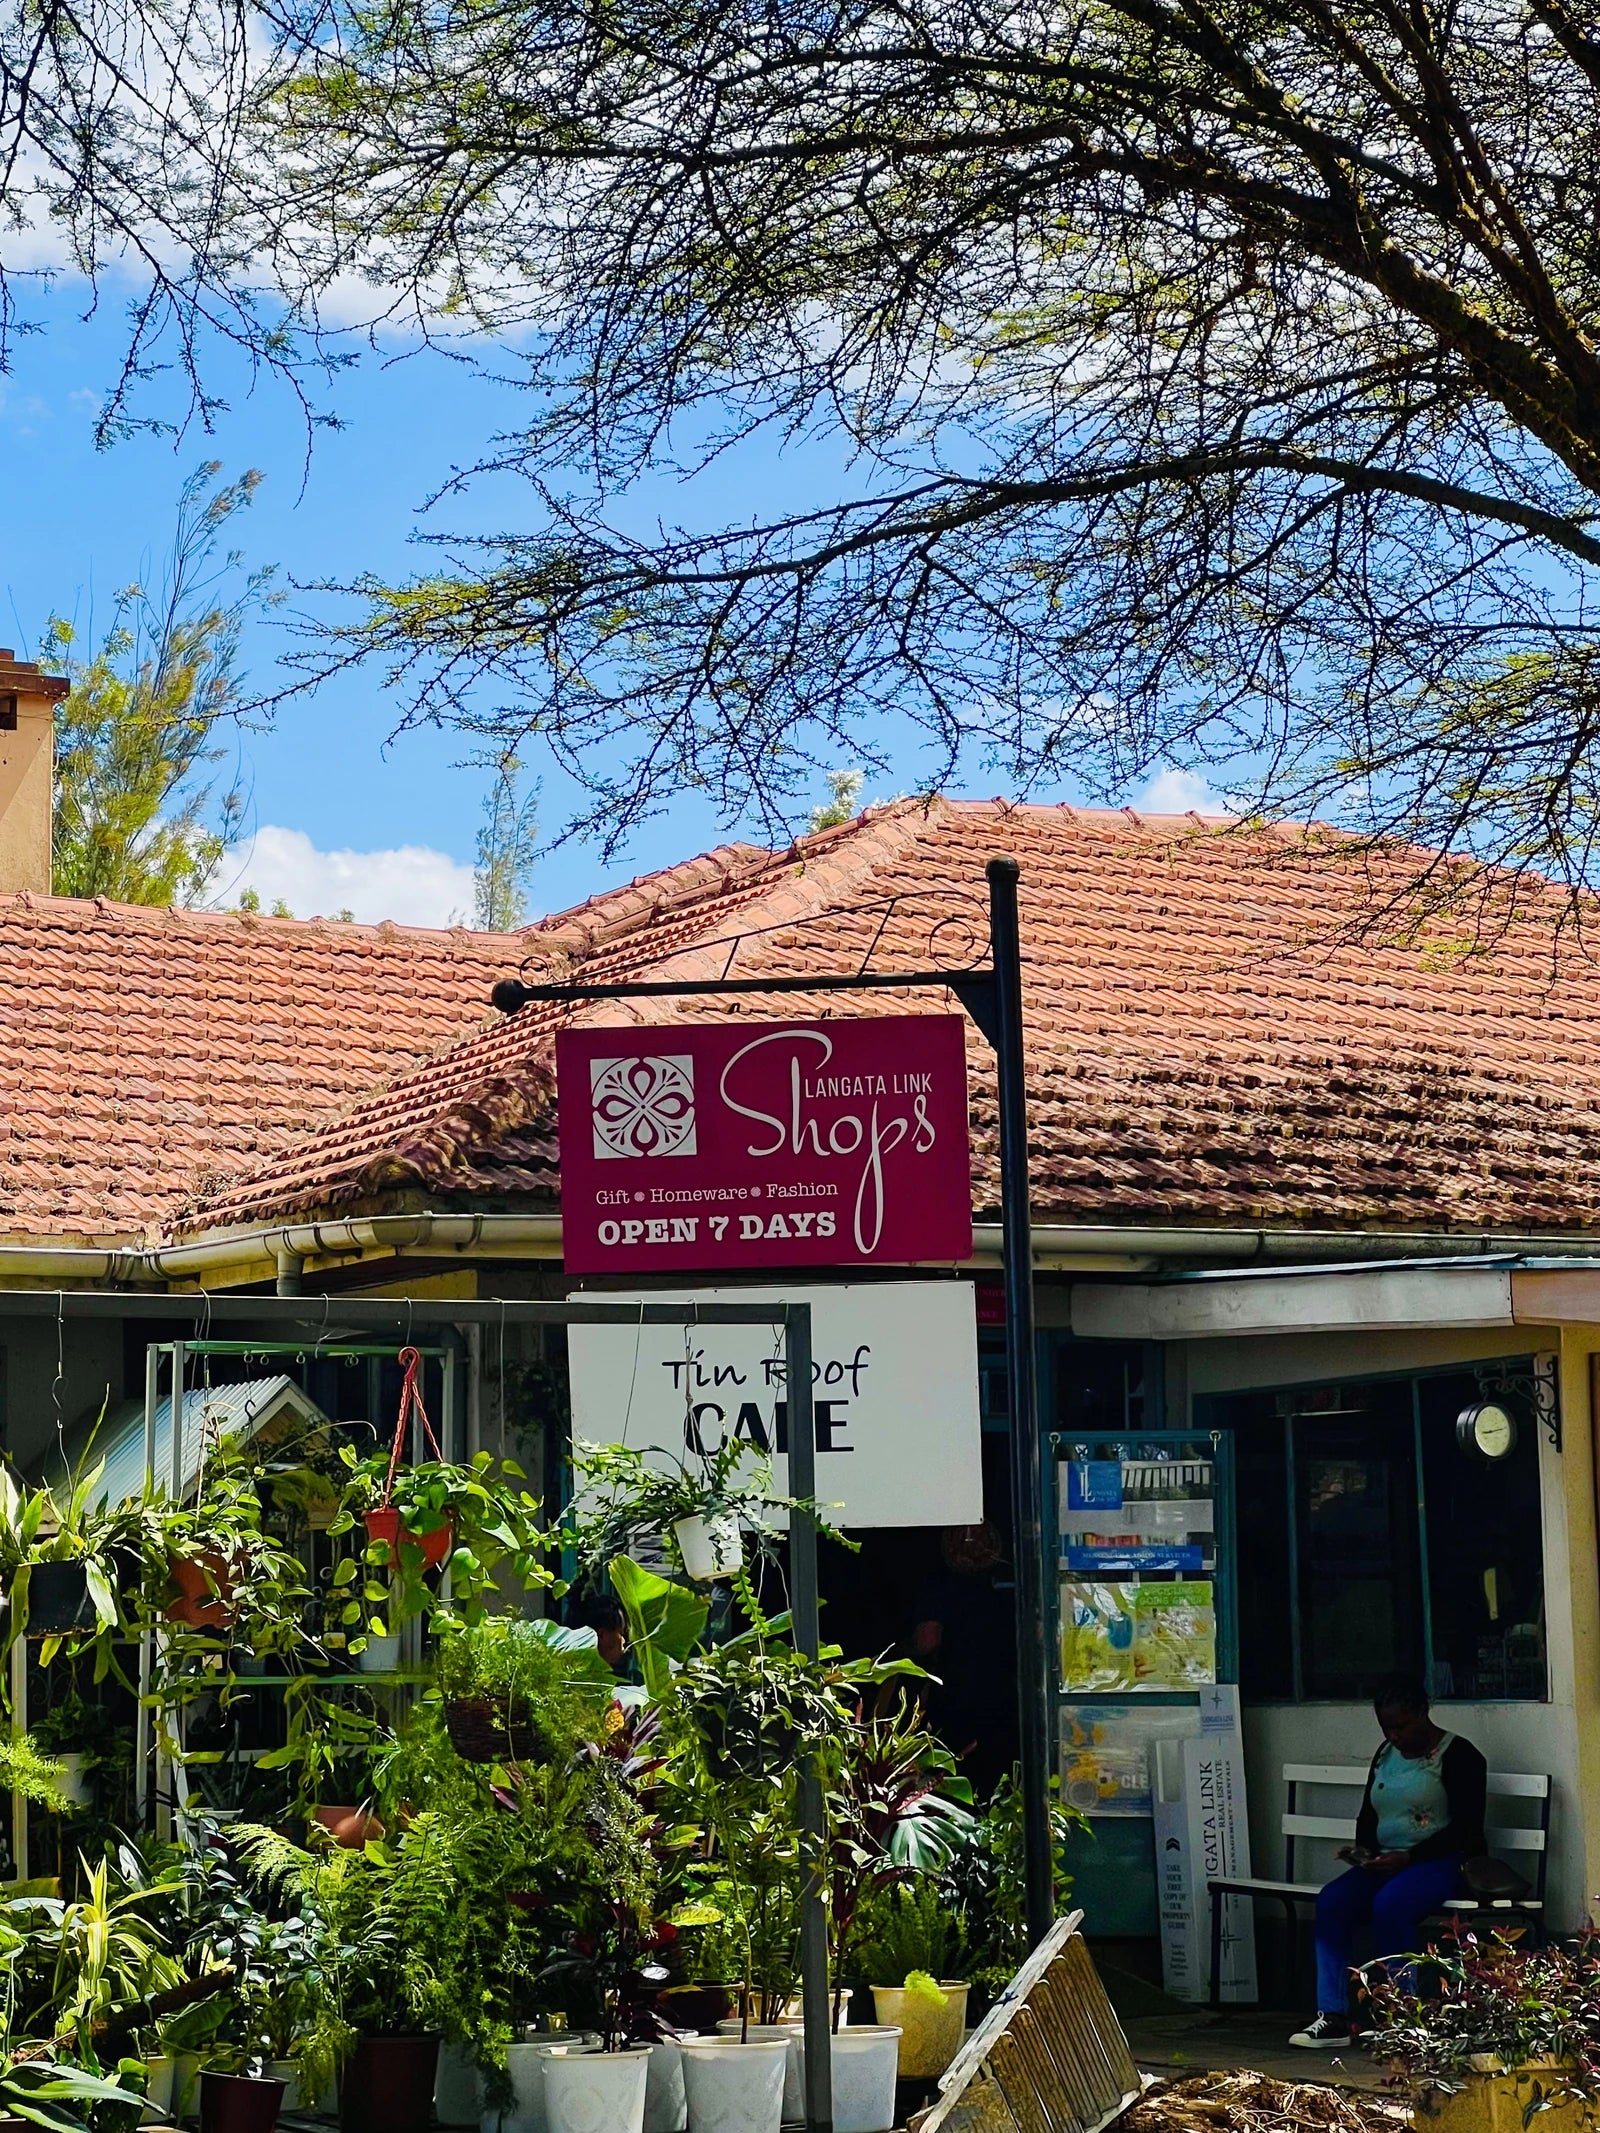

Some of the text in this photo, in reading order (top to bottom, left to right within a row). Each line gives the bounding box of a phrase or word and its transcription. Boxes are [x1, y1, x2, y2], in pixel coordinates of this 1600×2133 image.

[805, 1073, 932, 1098] LANGATA LINK
[720, 1029, 936, 1254] Shops
[596, 1182, 839, 1206] Gift Homeware Fashion
[598, 1211, 837, 1246] OPEN 7 DAYS
[662, 1349, 747, 1389] Tin
[1200, 1761, 1215, 1811] LINK
[1215, 1759, 1226, 1828] REAL ESTATE
[1228, 1809, 1236, 1871] MANAGEMENT
